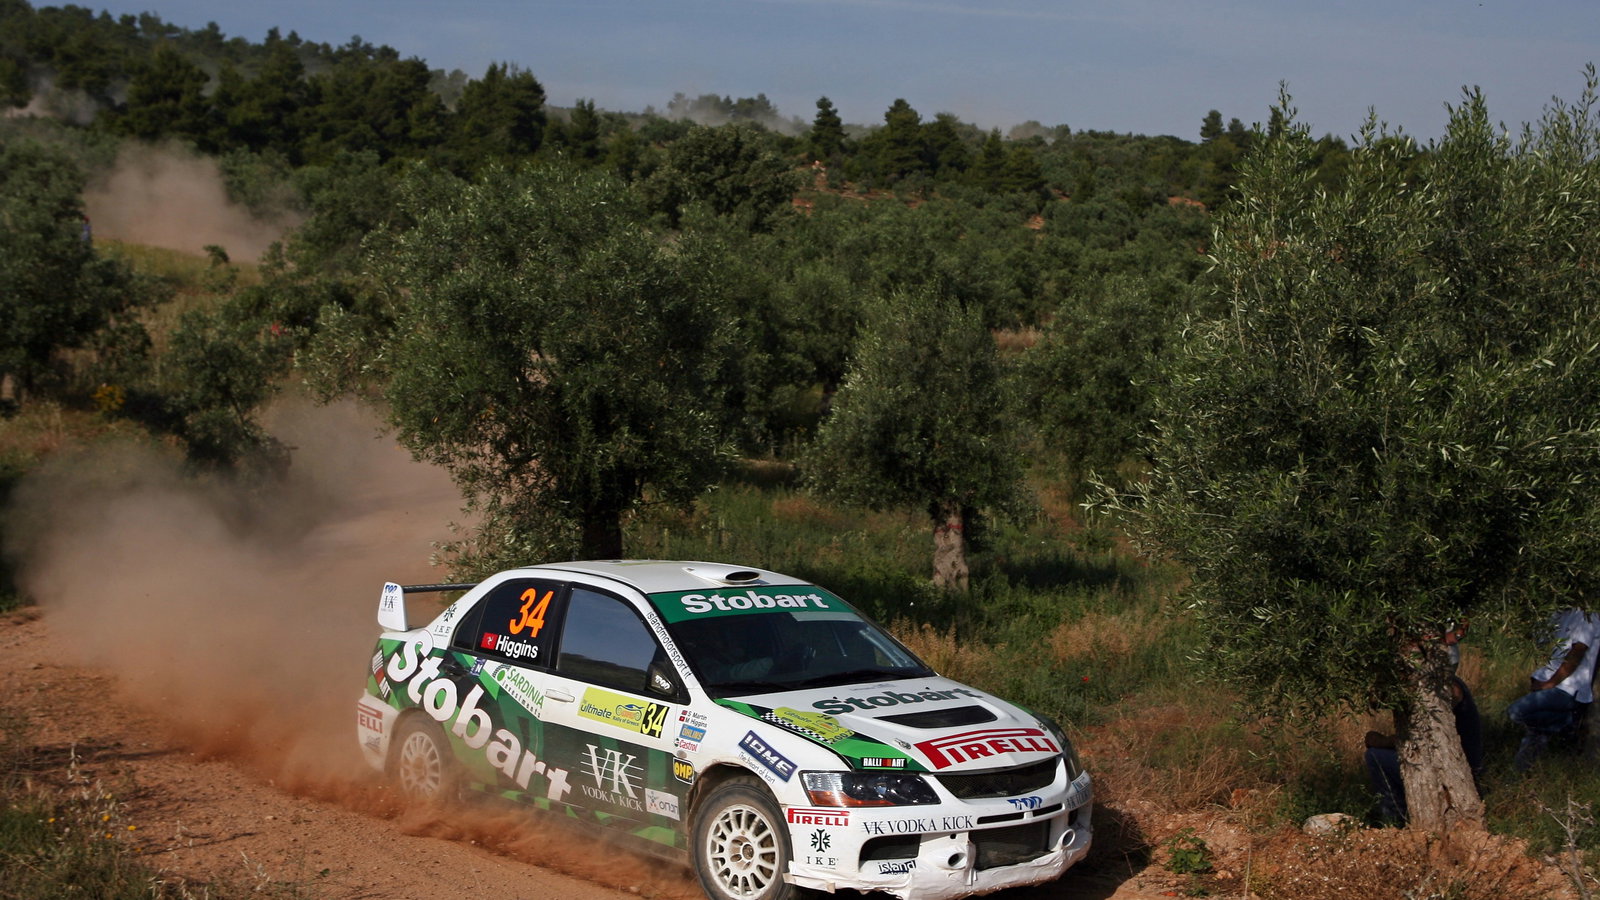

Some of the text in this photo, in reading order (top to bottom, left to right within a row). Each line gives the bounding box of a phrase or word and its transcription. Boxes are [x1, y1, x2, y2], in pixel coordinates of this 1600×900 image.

[509, 587, 554, 638] 34
[681, 590, 829, 614] Stobart
[495, 634, 539, 659] Higgins
[646, 611, 693, 679] islandmotorsport.it
[507, 668, 545, 710] SARDINIA
[811, 687, 983, 716] Stobart
[386, 628, 572, 801] Stobart
[580, 702, 612, 719] ultimate
[641, 703, 669, 738] 34
[691, 718, 708, 728] Higgins
[680, 739, 699, 752] Castrol
[913, 727, 1060, 770] PIRELLI
[585, 743, 639, 800] VK
[673, 761, 693, 780] OMP
[581, 784, 644, 813] VODKA KICK
[787, 808, 850, 827] PIRELLI
[862, 815, 974, 835] VK VODKA KICK
[806, 855, 837, 866] IKE
[877, 859, 917, 874] island
